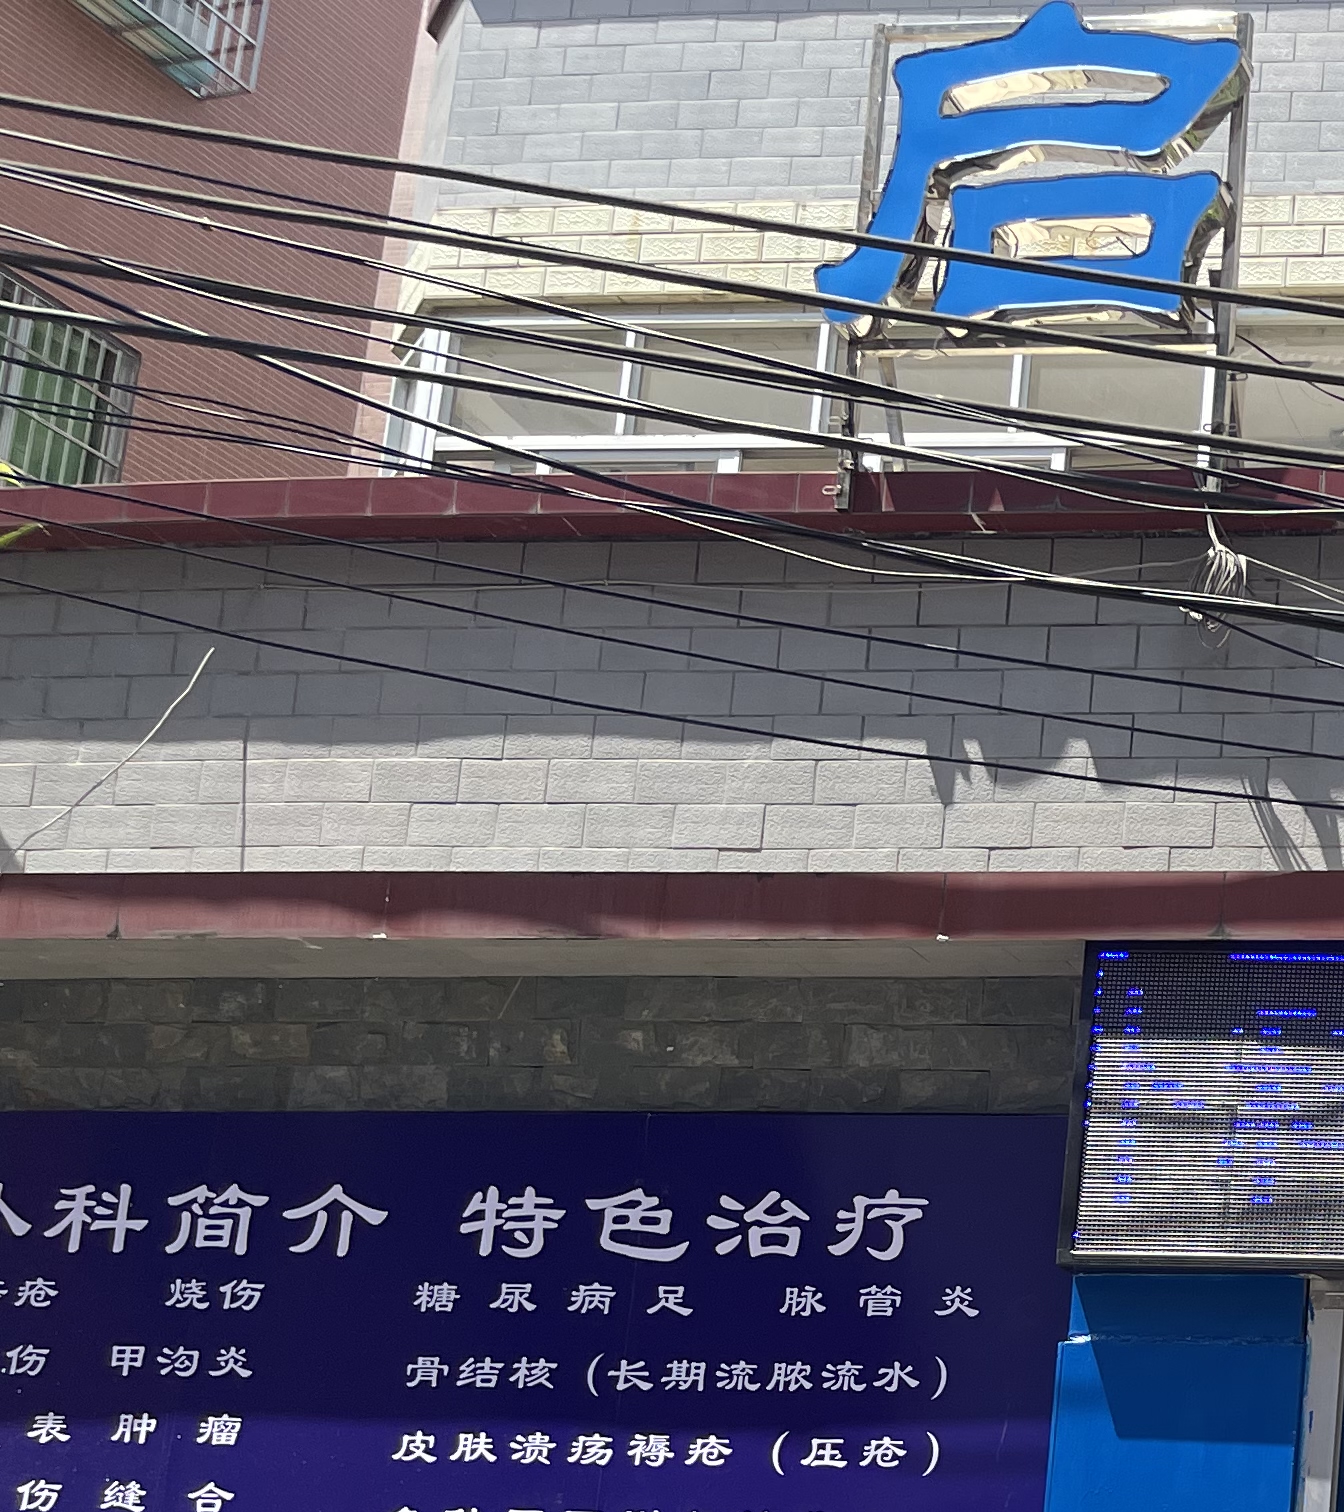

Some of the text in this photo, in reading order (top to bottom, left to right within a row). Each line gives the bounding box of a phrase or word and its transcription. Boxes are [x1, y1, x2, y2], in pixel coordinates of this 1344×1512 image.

[0, 1183, 931, 1263] 科简介 特色治疗
[0, 1276, 266, 1312] 疮 烧伤
[412, 1280, 981, 1318] 糖尿病足 脉管炎
[110, 1344, 254, 1379] 甲沟炎
[405, 1352, 948, 1401] 骨结核（长期流脓流水）
[25, 1410, 244, 1447] 表肿瘤
[390, 1429, 941, 1478] 皮肤溃疡褥疮（压疮）
